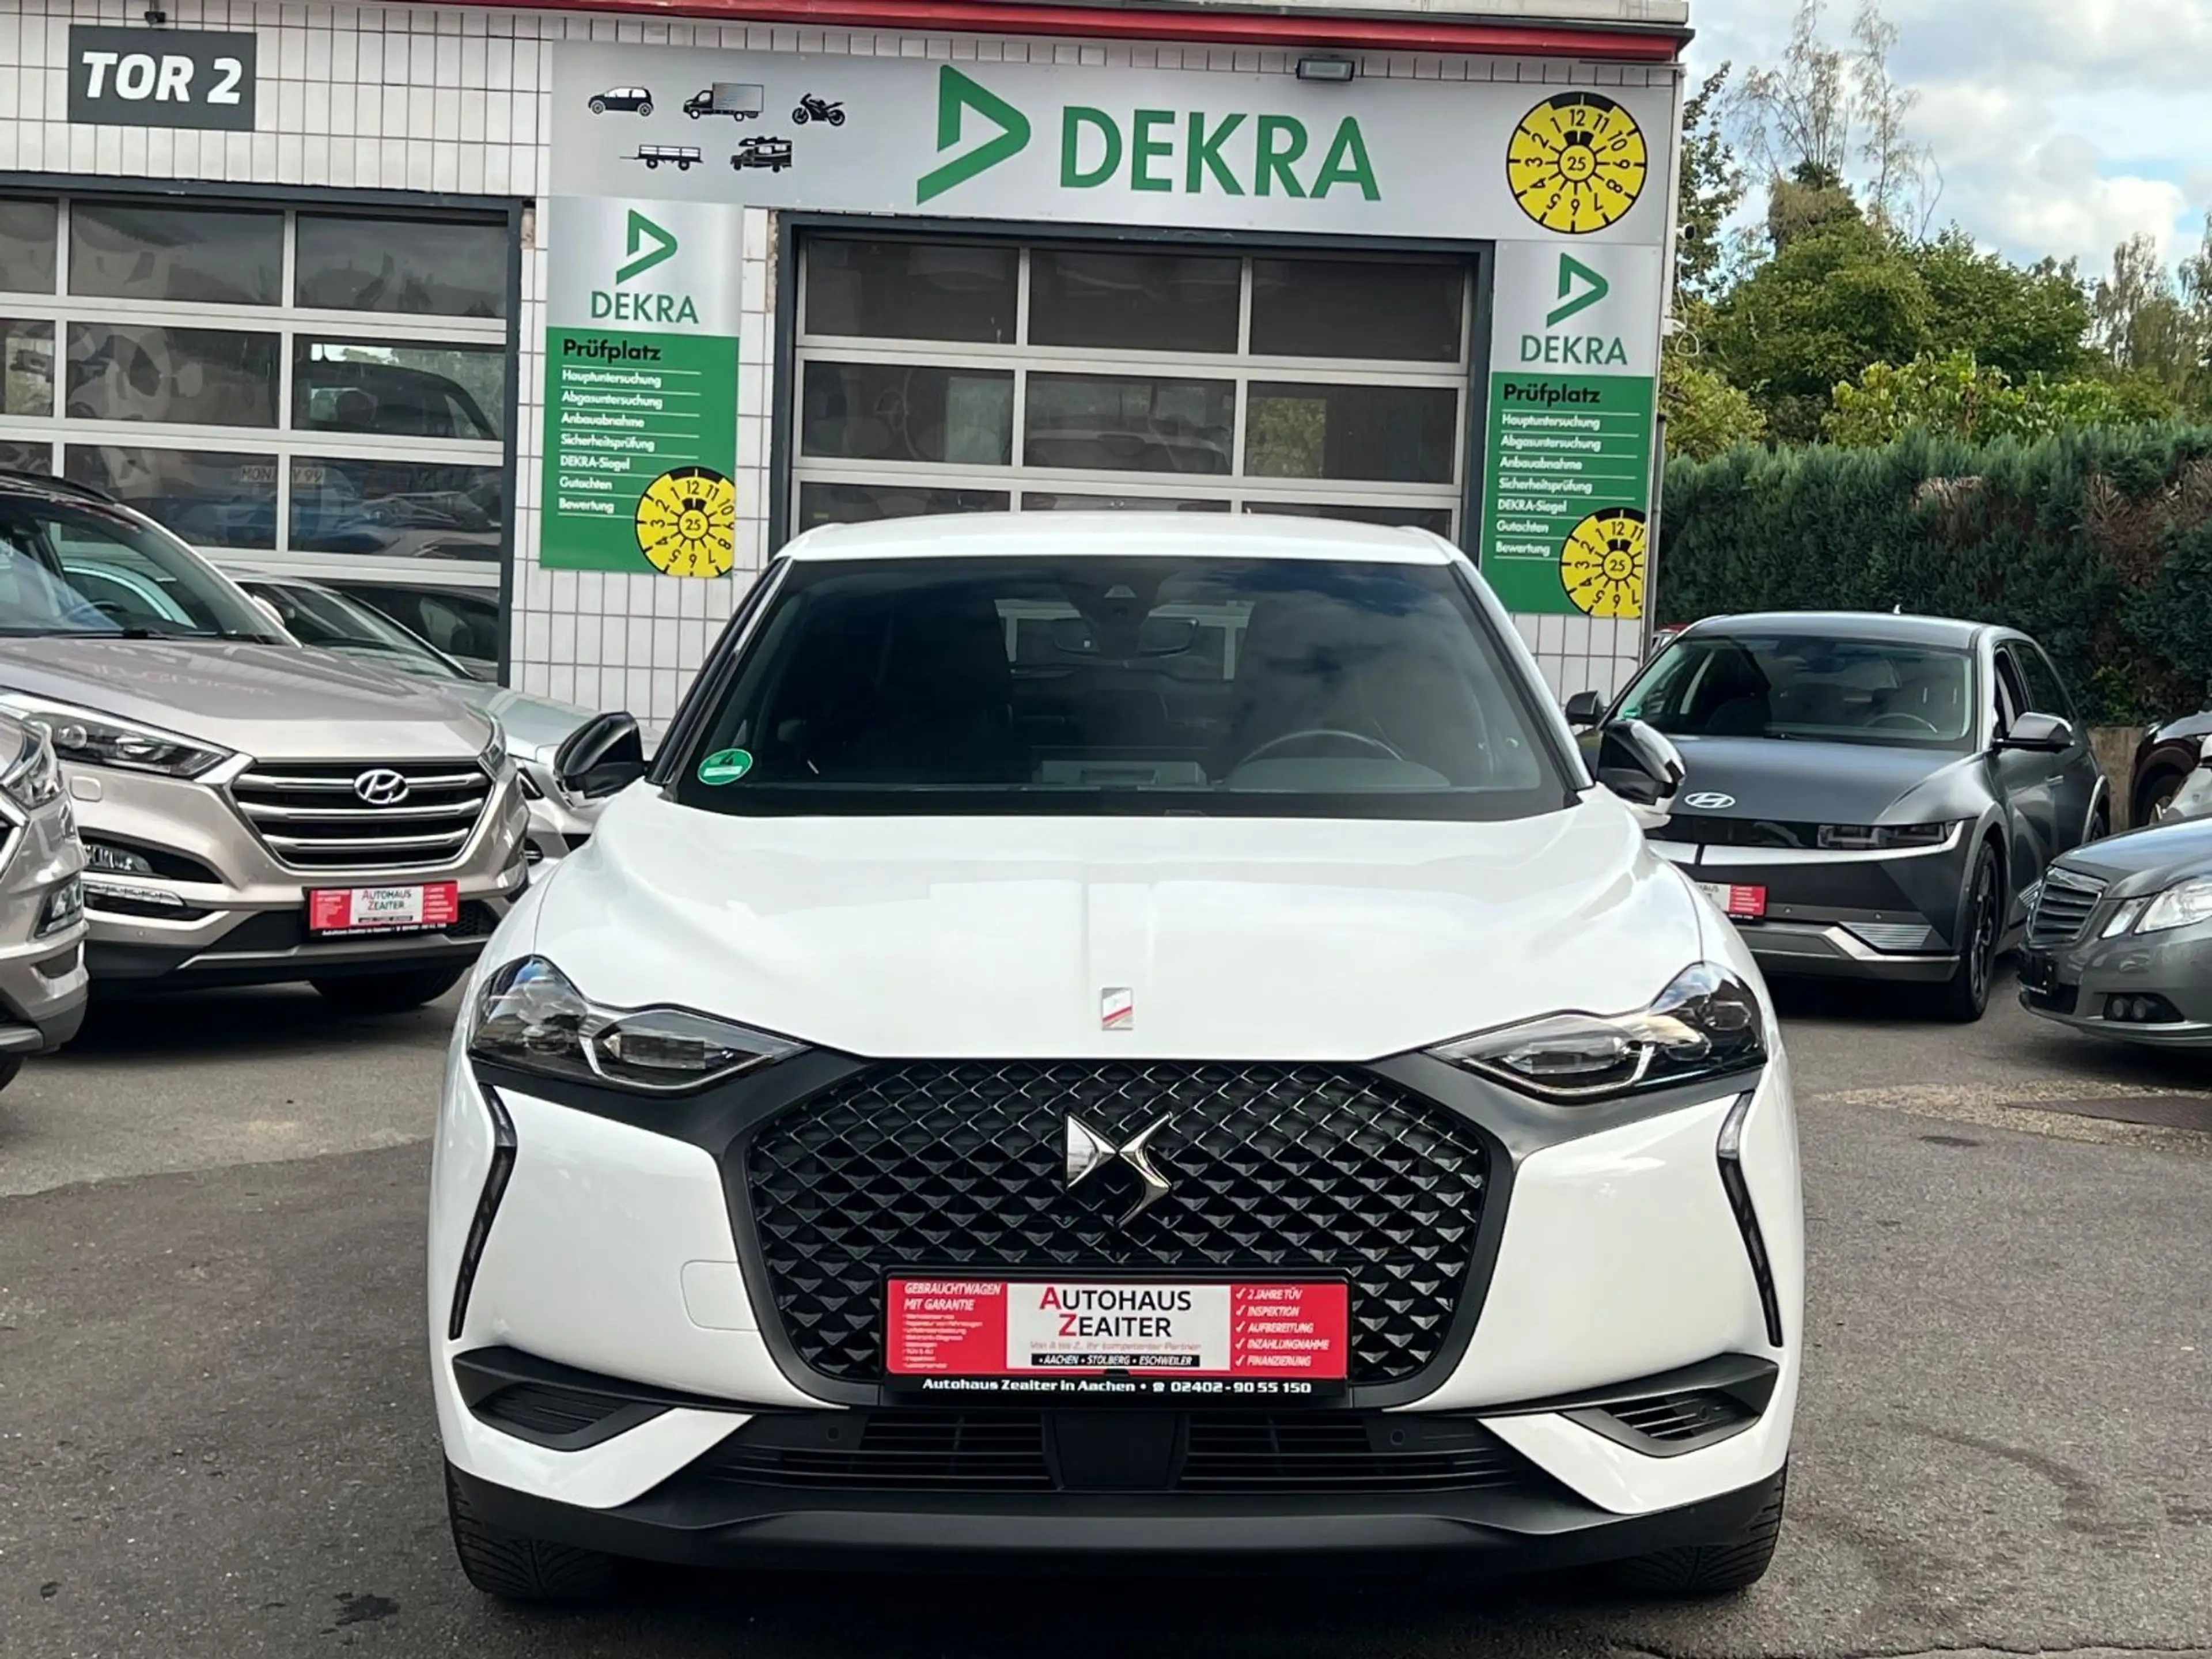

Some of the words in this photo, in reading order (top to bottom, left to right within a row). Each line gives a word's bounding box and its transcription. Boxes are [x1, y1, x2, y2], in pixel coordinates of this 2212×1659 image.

[81, 52, 194, 102] TOR
[207, 58, 242, 105] 2
[1550, 117, 1562, 133] 1
[1569, 109, 1585, 126] 12
[1593, 113, 1609, 133] 11
[1532, 132, 1550, 149] 2
[1607, 130, 1627, 152] 10
[1060, 106, 1381, 202] DEKRA
[1525, 156, 1544, 168] 3
[1567, 156, 1586, 172] 25
[1529, 177, 1547, 190] 4
[1606, 179, 1623, 194] 8
[1546, 193, 1562, 210] 5
[1593, 192, 1604, 211] 7
[592, 291, 699, 324] DEKRA
[563, 339, 661, 364] Prüfplatz
[1520, 334, 1628, 366] DEKRA
[562, 369, 662, 389] Hauptuntersuchung
[561, 391, 663, 410] Abgasuntersuchung
[1503, 382, 1601, 407] Prüfplatz
[560, 412, 645, 428] Anbauabnahme
[1501, 413, 1601, 431] Hauptuntersuchung
[560, 434, 655, 452] Sicherheitsprüfung
[1500, 434, 1602, 453] Abgasuntersuchung
[559, 455, 630, 471] DEKRA-Siegel
[1499, 456, 1582, 470] Anbauabnahme
[559, 477, 612, 491] Gutachten
[686, 480, 700, 495] 12
[1498, 478, 1593, 494] Sicherheitsprüfung
[670, 487, 680, 500] 1
[704, 484, 720, 501] 11
[558, 498, 615, 513] Bewertung
[656, 499, 670, 512] 2
[717, 498, 734, 516] 10
[1498, 499, 1567, 515] DEKRA-Siegel
[650, 520, 666, 529] 3
[685, 518, 701, 531] 25
[1496, 520, 1549, 533] Gutachten
[1611, 521, 1624, 536] 12
[1595, 528, 1605, 541] 1
[1631, 525, 1645, 541] 11
[656, 536, 669, 546] 4
[717, 538, 732, 550] 8
[1495, 541, 1550, 556] Bewertung
[1580, 541, 1594, 554] 2
[669, 549, 681, 563] 5
[707, 549, 717, 564] 7
[1574, 560, 1590, 570] 3
[1609, 559, 1626, 572] 25
[1579, 577, 1592, 586] 4
[1593, 590, 1605, 604] 5
[1631, 589, 1641, 604] 7
[904, 1282, 1001, 1295] GEBRAUCHTWAGEN
[1248, 1289, 1255, 1300] 2
[1255, 1289, 1283, 1300] JAHRE
[1284, 1287, 1303, 1300] TÜV
[904, 1298, 923, 1310] MIT
[924, 1299, 975, 1310] GARANTIE
[1039, 1287, 1191, 1311] AUTOHAUS
[1247, 1306, 1300, 1317] INSPEKTION
[1058, 1313, 1172, 1337] ZEAITER
[1248, 1322, 1314, 1334] AUFBEREITUNG
[1044, 1354, 1078, 1365] AACHEN
[1086, 1355, 1130, 1365] STOLBERG
[1139, 1355, 1192, 1366] ESCHWEILER
[1247, 1355, 1312, 1367] FINANZIERUNG
[923, 1378, 998, 1390] Autohaus
[1060, 1380, 1075, 1391] in
[1077, 1380, 1136, 1392] Aachen
